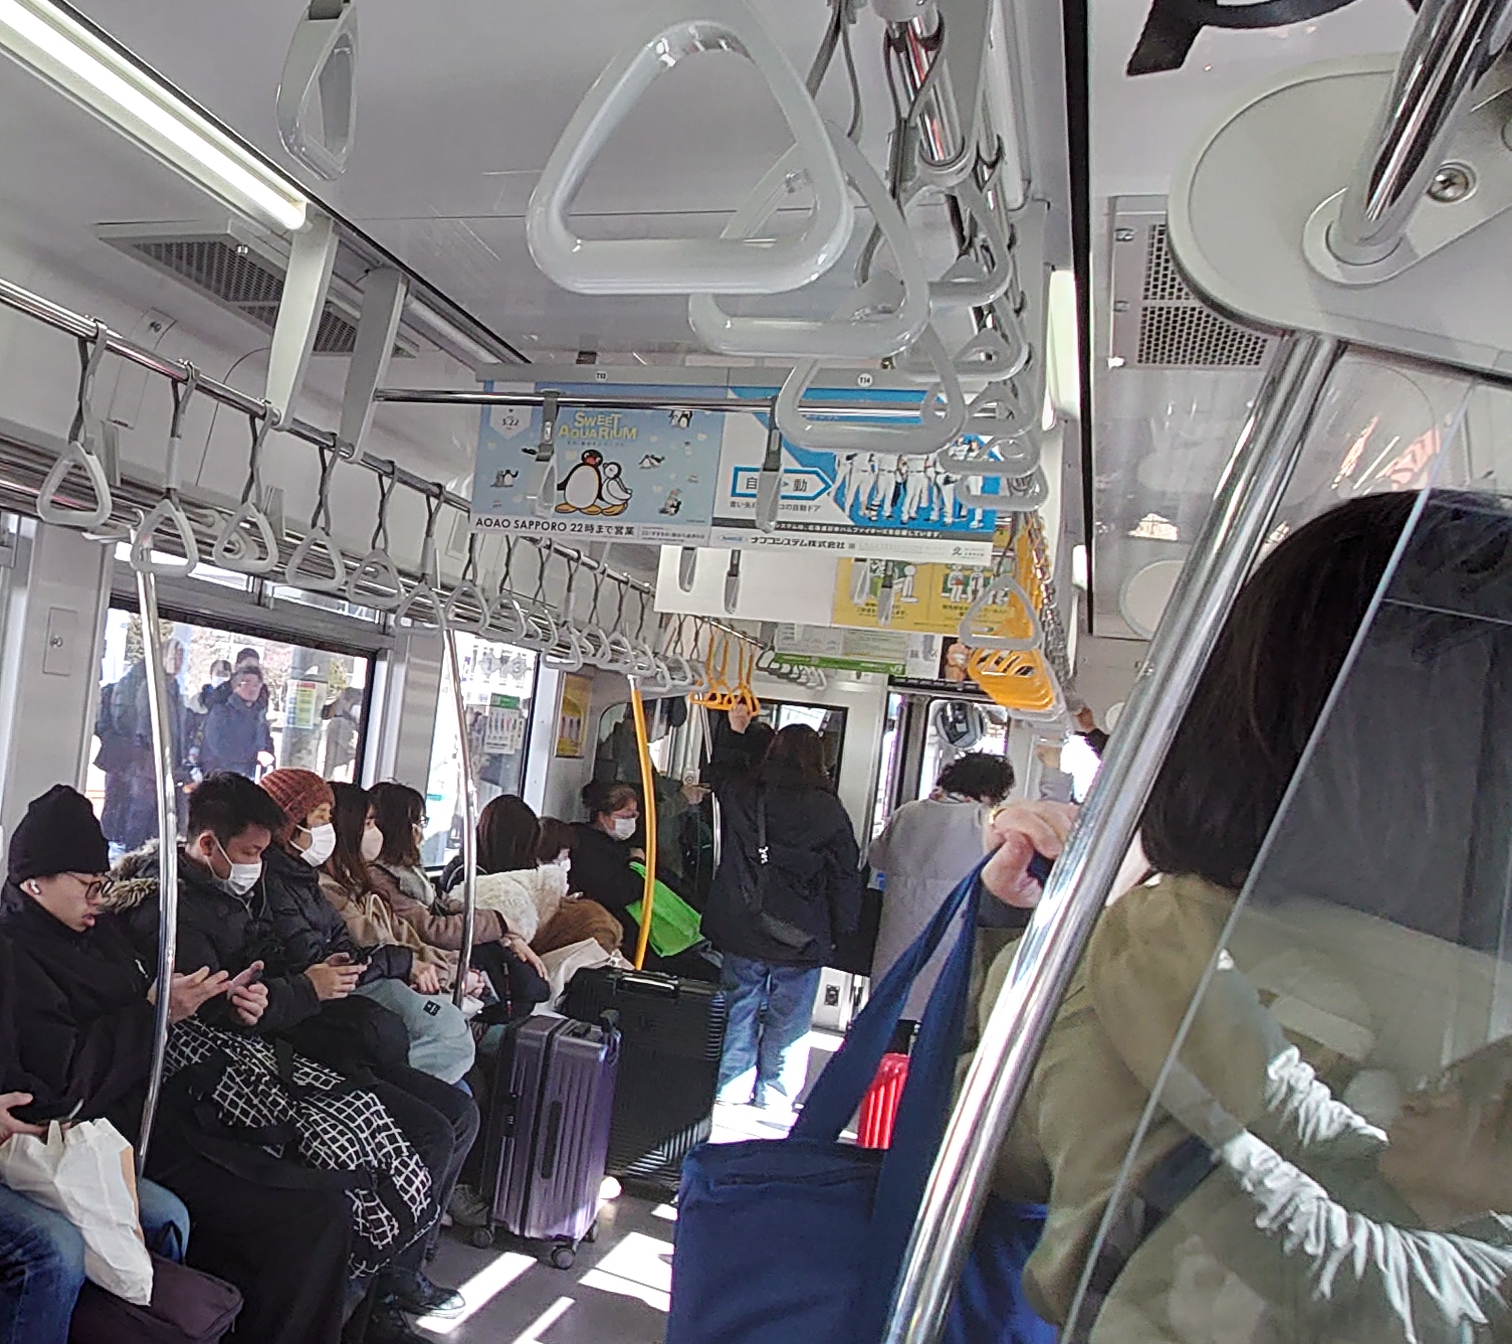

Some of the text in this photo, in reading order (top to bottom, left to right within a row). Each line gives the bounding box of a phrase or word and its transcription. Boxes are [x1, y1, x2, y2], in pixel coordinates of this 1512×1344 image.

[574, 410, 623, 429] SWEET
[557, 424, 638, 440] AQUARIUM
[475, 517, 512, 529] AOAO
[514, 519, 567, 532] SAPPORO
